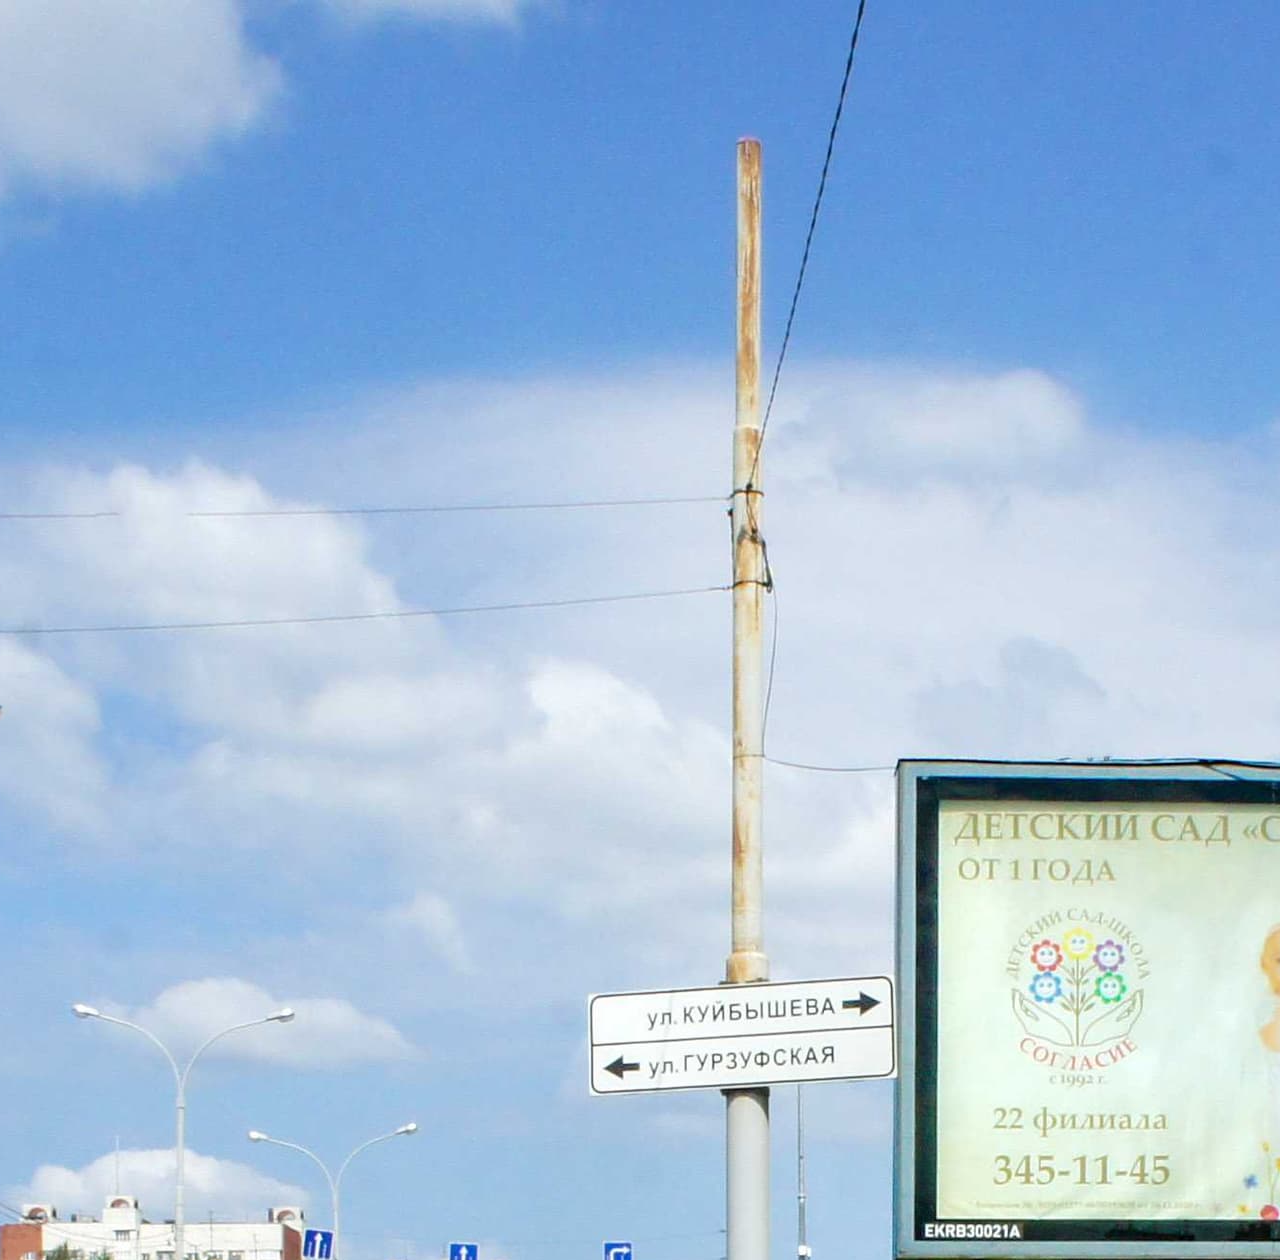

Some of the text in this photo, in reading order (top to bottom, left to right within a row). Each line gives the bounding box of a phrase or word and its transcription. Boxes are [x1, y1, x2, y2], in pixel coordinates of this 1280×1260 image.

[1151, 814, 1232, 848] САД
[958, 858, 1116, 886] ОТ 1 ГОДА
[647, 997, 836, 1031] ул. КУЙБЫШЕВА
[649, 1046, 835, 1078] ул. ГУРЗУФСКАЯ
[1020, 1036, 1138, 1072] СОГЛАСИЕ
[1060, 1074, 1095, 1088] 1992
[993, 1106, 1169, 1138] 22 филиала
[993, 1155, 1171, 1186] 345-11-45
[924, 1223, 1021, 1239] EKRB30021A
